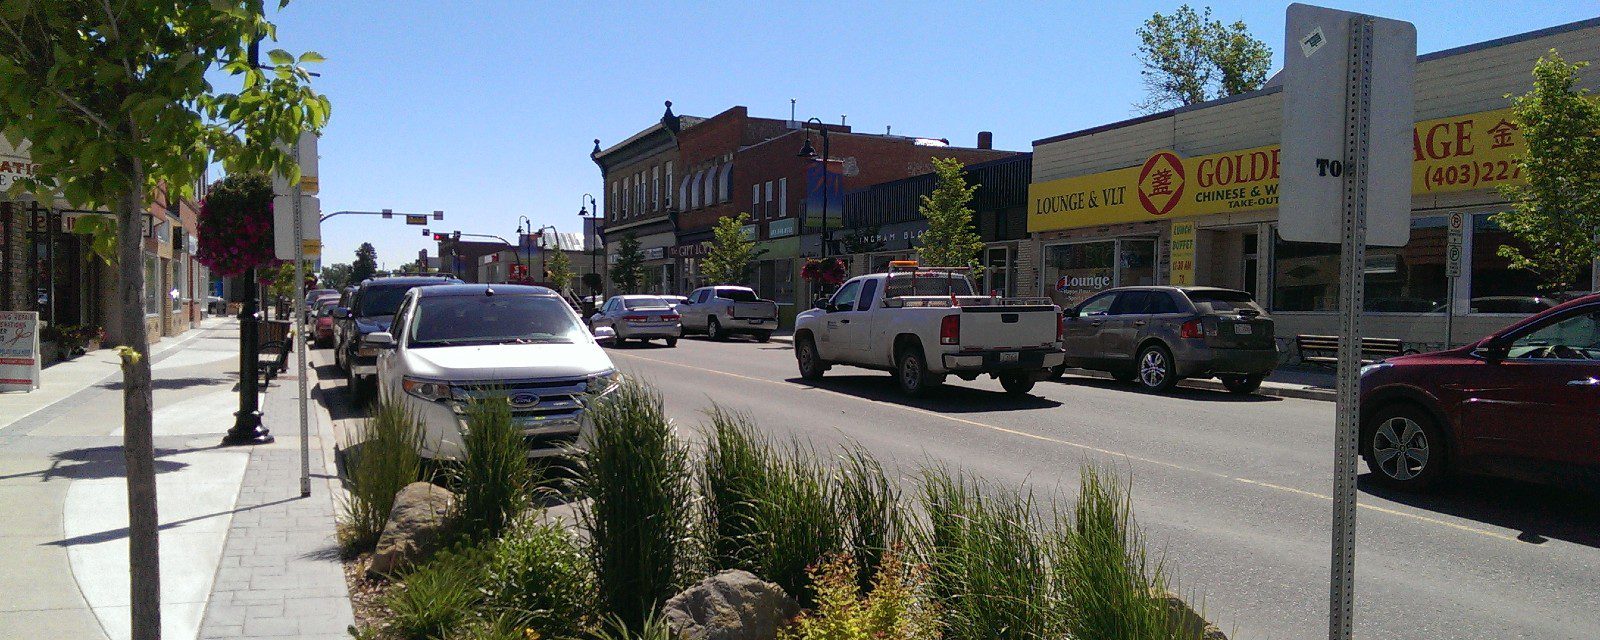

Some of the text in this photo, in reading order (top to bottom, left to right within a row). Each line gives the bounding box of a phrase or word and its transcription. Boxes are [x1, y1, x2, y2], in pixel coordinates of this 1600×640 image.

[1487, 118, 1519, 150] 金
[1036, 186, 1127, 215] LOUNGE & VLT
[1195, 187, 1246, 203] CHINESE
[1250, 185, 1262, 198] &
[1228, 195, 1280, 209] TAKE-OUT
[679, 245, 694, 257] GIFT
[1063, 275, 1110, 289] Lounge
